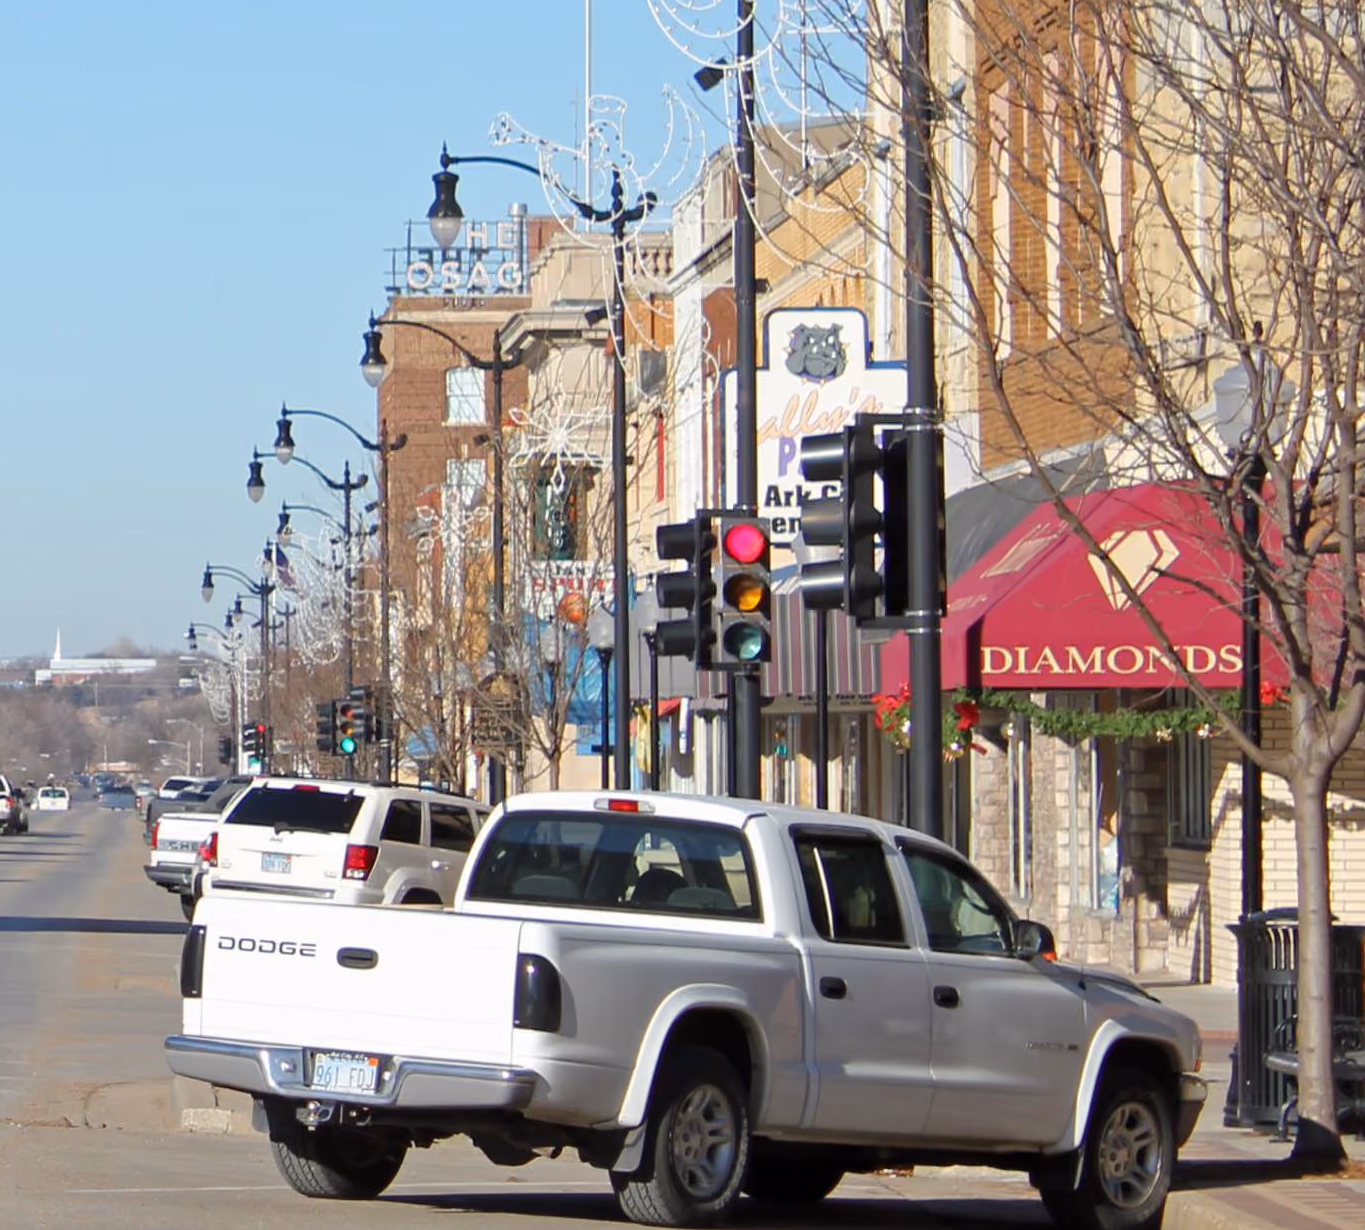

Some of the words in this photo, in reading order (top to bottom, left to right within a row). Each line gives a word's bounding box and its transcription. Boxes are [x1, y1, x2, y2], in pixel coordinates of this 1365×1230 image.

[464, 221, 515, 249] HE
[406, 261, 523, 289] OSAG
[757, 386, 884, 446] ally's
[980, 644, 1245, 675] DIAMONDS
[218, 935, 317, 958] DODGE
